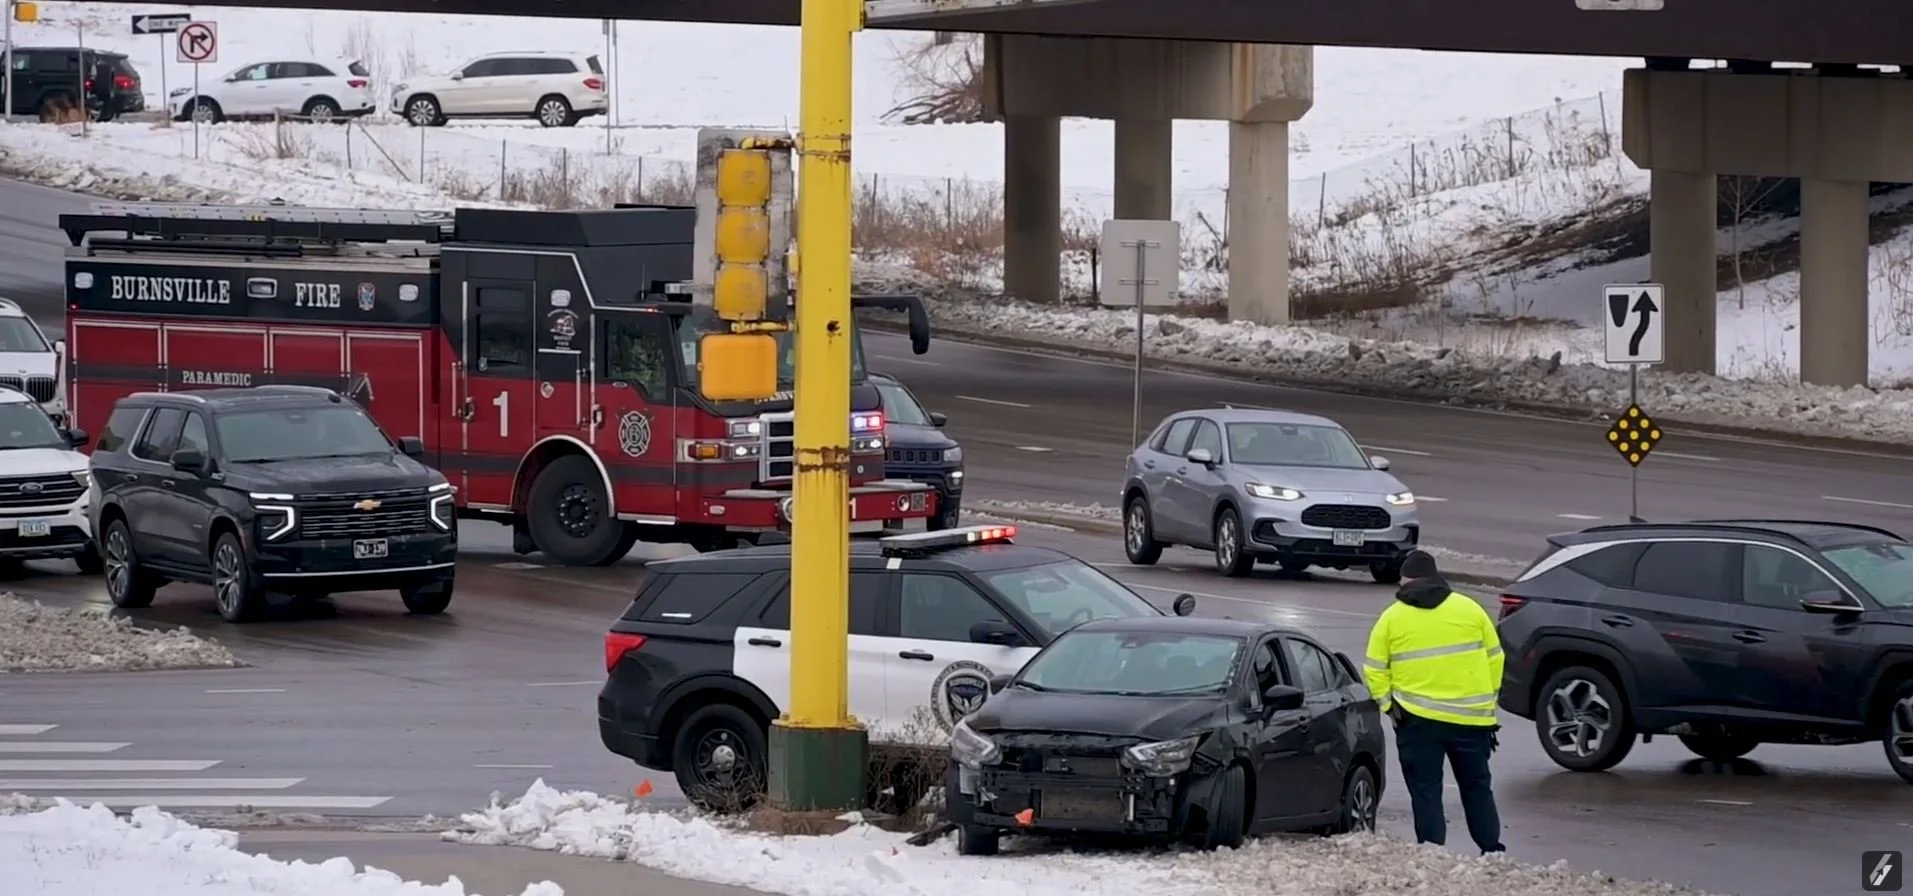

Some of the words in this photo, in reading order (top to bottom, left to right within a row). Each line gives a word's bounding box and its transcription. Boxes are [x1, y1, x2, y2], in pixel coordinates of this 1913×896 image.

[111, 276, 230, 303] BURNSVILLE
[294, 282, 341, 308] FIRE
[182, 370, 252, 386] PARAMEDIC
[493, 391, 509, 438] 1
